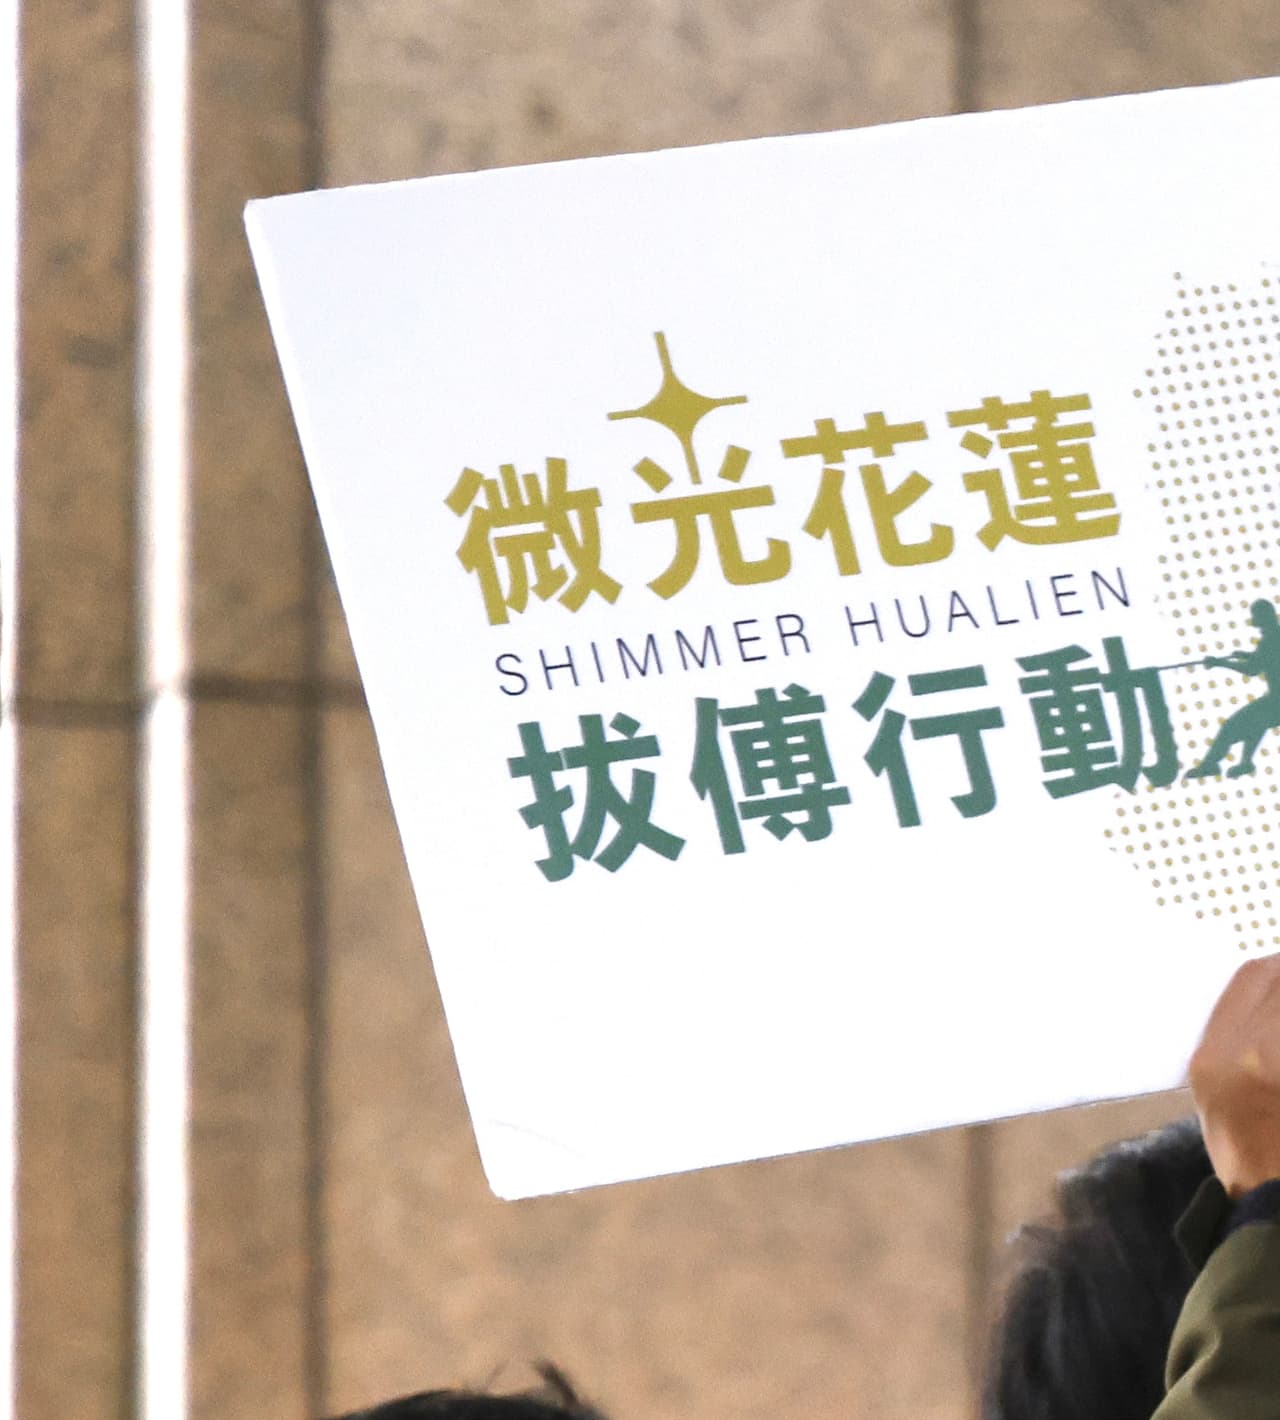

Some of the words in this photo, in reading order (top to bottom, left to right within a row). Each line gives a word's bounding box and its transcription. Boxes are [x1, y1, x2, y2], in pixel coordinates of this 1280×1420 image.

[444, 388, 1123, 626] 微光花蓮
[494, 613, 812, 696] SHIMMER
[845, 566, 1132, 647] HUALIEN
[507, 635, 1179, 883] 拔傅行動
